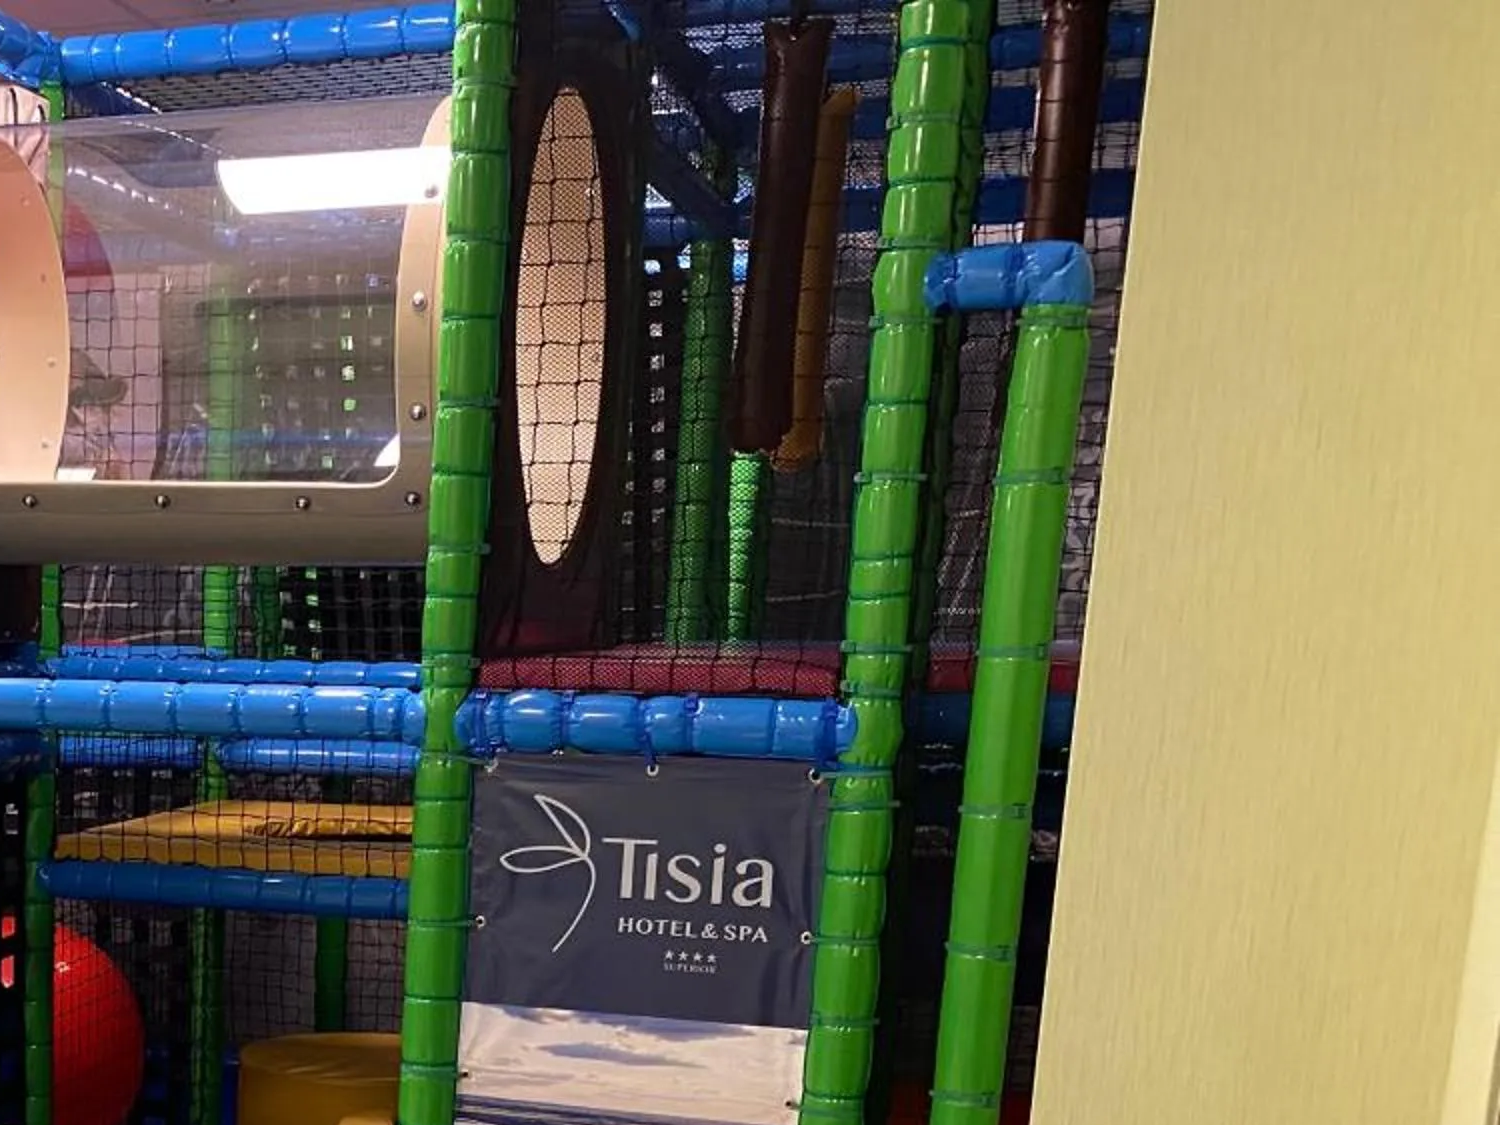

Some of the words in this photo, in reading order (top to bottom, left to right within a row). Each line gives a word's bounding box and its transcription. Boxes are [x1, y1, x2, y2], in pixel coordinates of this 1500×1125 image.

[602, 837, 774, 908] Tisia
[617, 917, 698, 939] HOTEL
[701, 923, 719, 940] &
[723, 924, 768, 943] SPA
